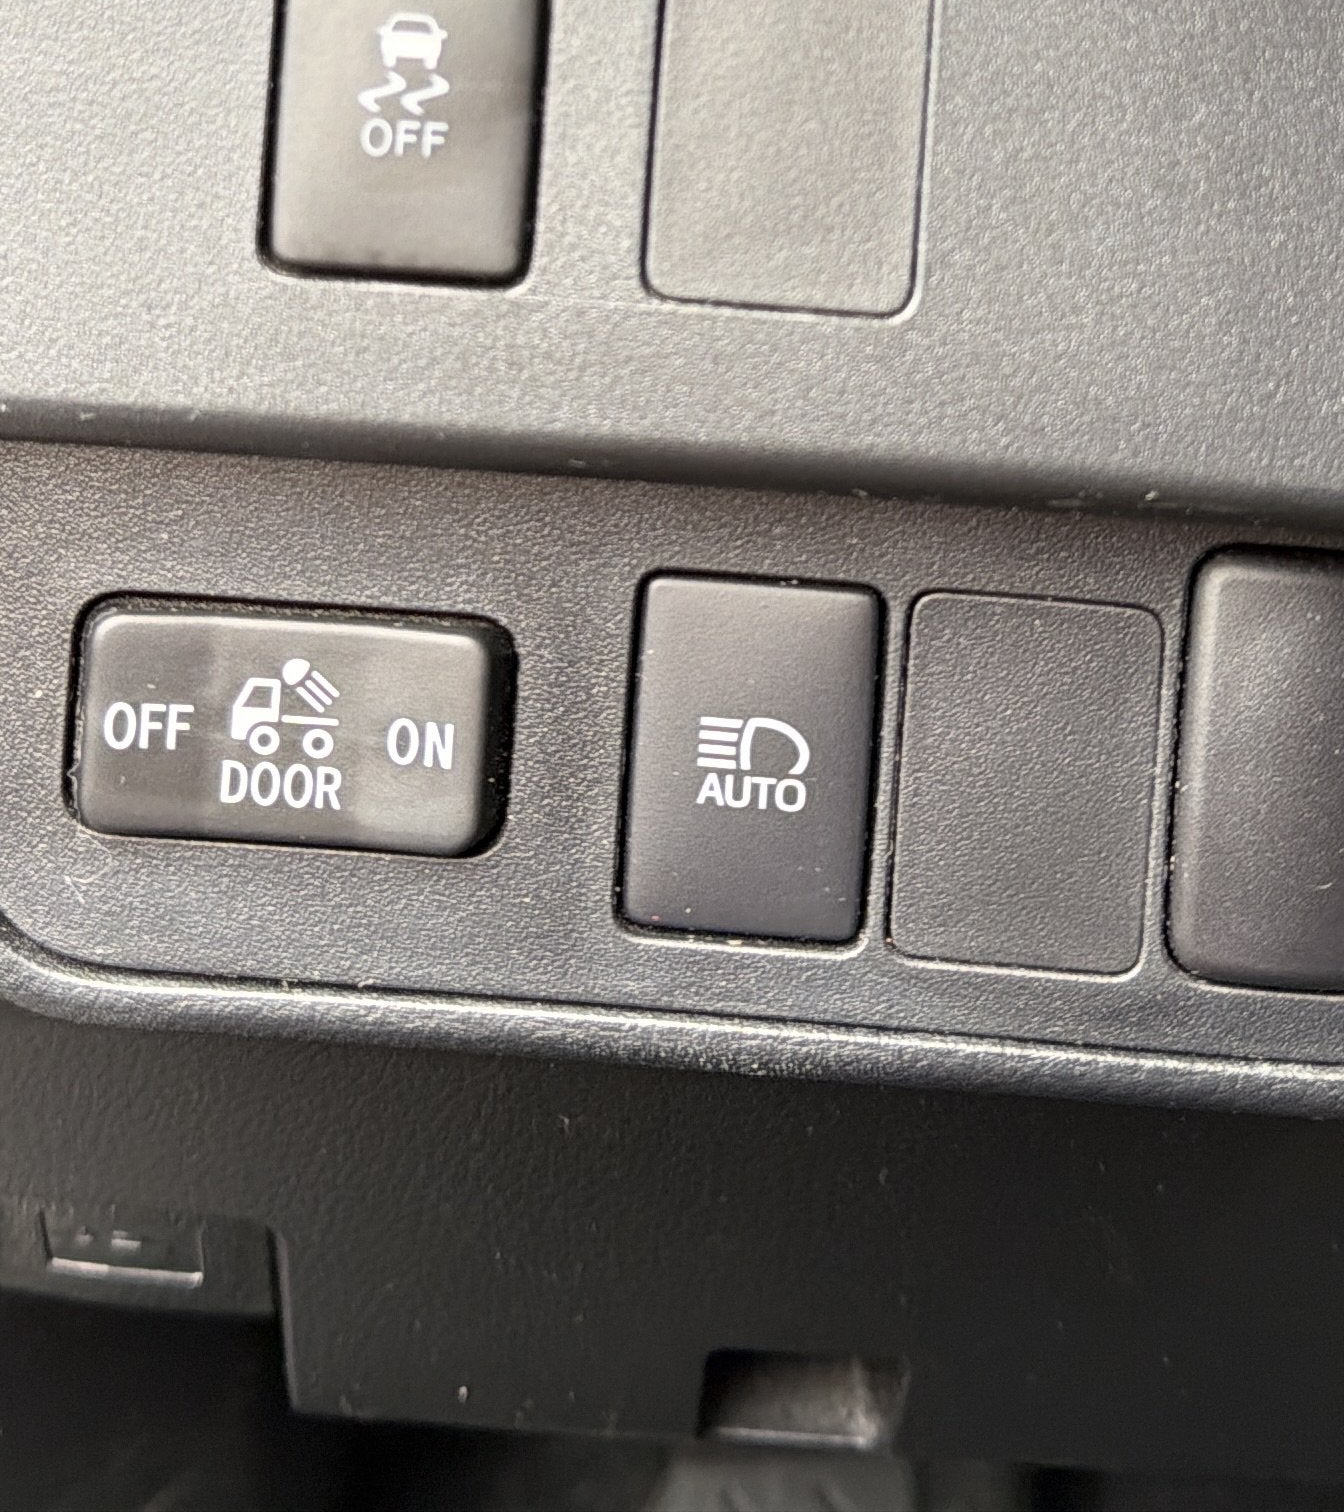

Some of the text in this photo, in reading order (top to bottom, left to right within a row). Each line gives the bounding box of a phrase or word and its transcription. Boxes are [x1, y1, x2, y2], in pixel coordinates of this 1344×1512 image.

[360, 118, 449, 158] OFF
[104, 701, 195, 750] OFF
[387, 717, 455, 770] ON
[220, 759, 341, 810] DOOR
[696, 772, 807, 812] AUTO
